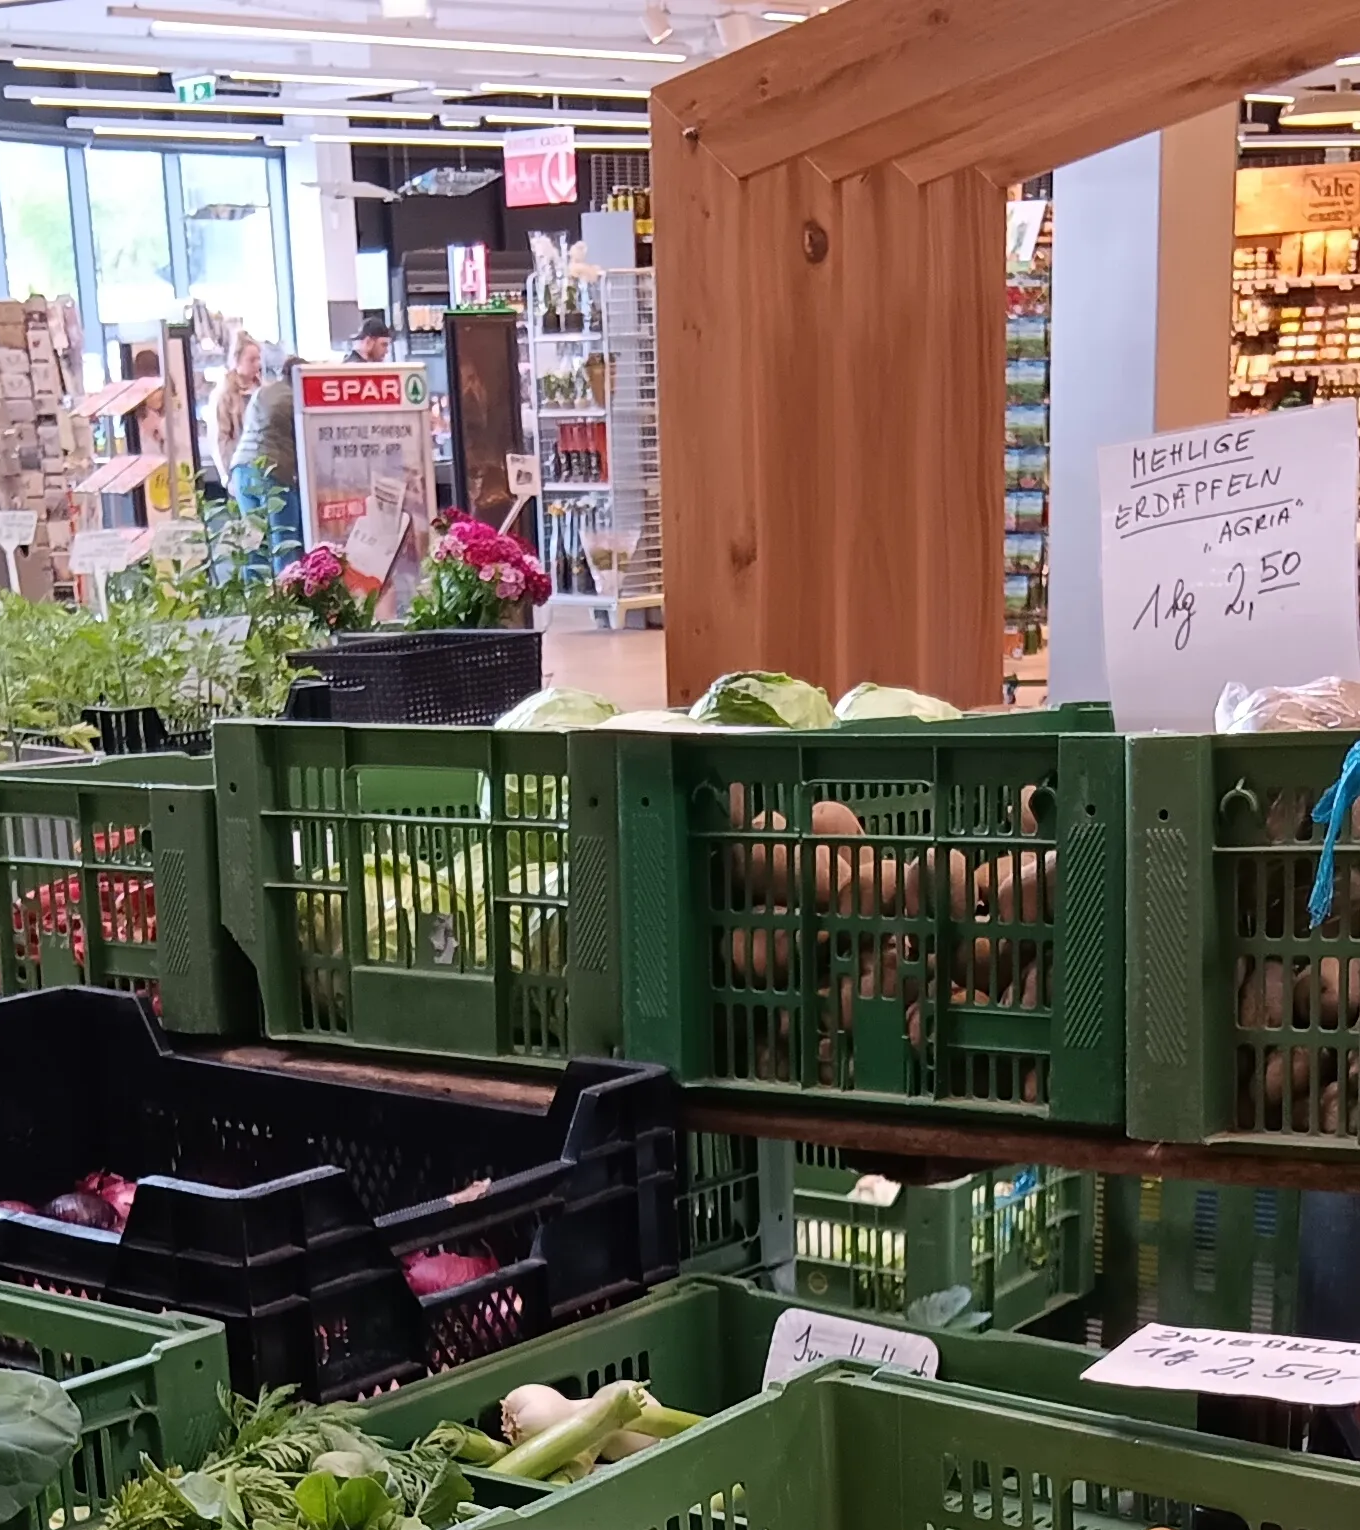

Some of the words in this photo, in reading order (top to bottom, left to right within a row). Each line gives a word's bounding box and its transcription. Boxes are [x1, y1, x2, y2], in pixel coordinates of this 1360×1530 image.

[322, 379, 400, 401] SPAR
[1131, 429, 1256, 480] MEHLIGE
[1114, 466, 1282, 530] ERDÄPFELN
